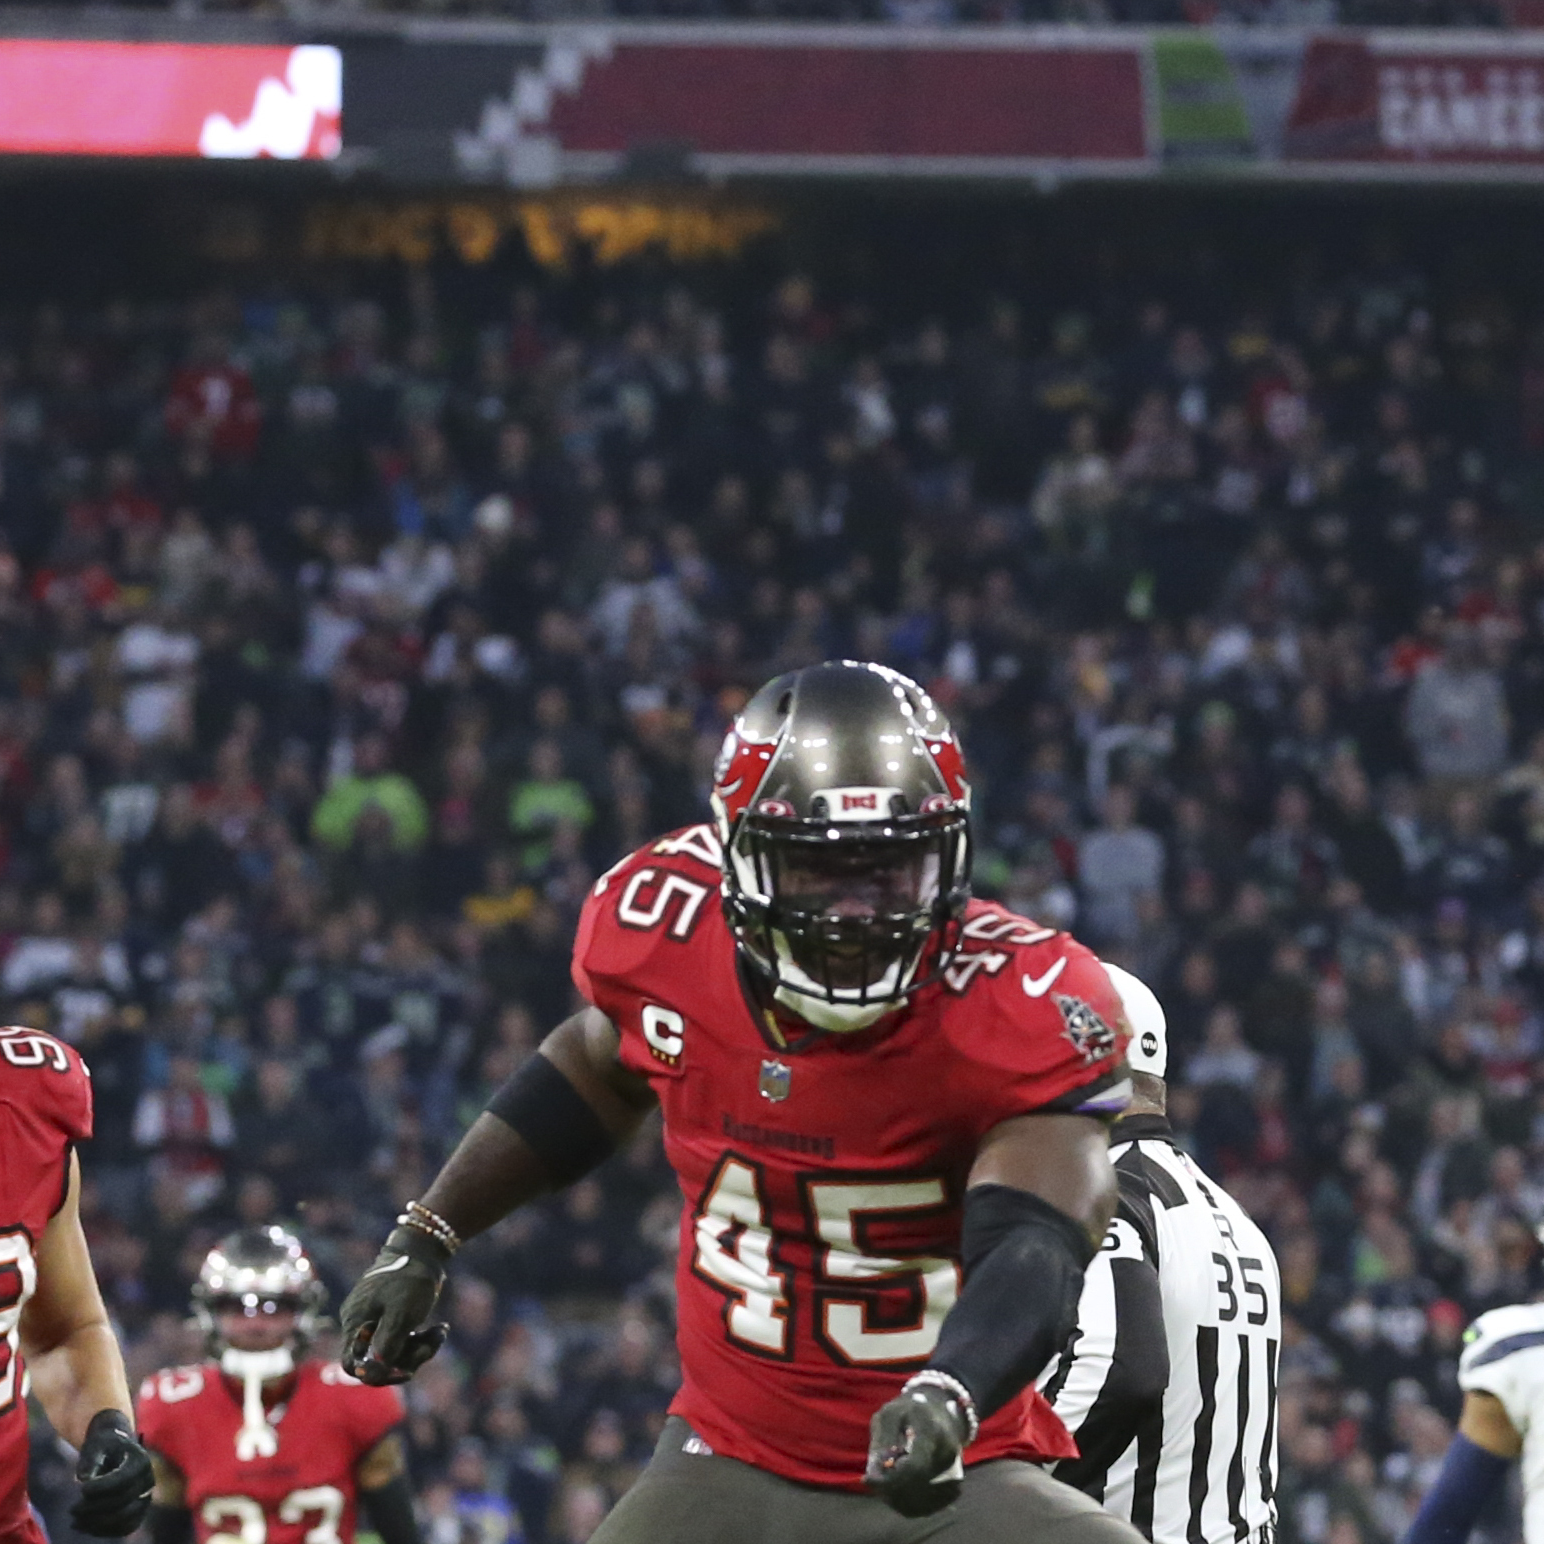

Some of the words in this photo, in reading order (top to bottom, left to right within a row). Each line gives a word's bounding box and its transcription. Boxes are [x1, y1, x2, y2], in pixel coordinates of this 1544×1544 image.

[641, 1002, 685, 1057] C
[693, 1152, 963, 1365] 45
[1212, 1252, 1269, 1327] 35
